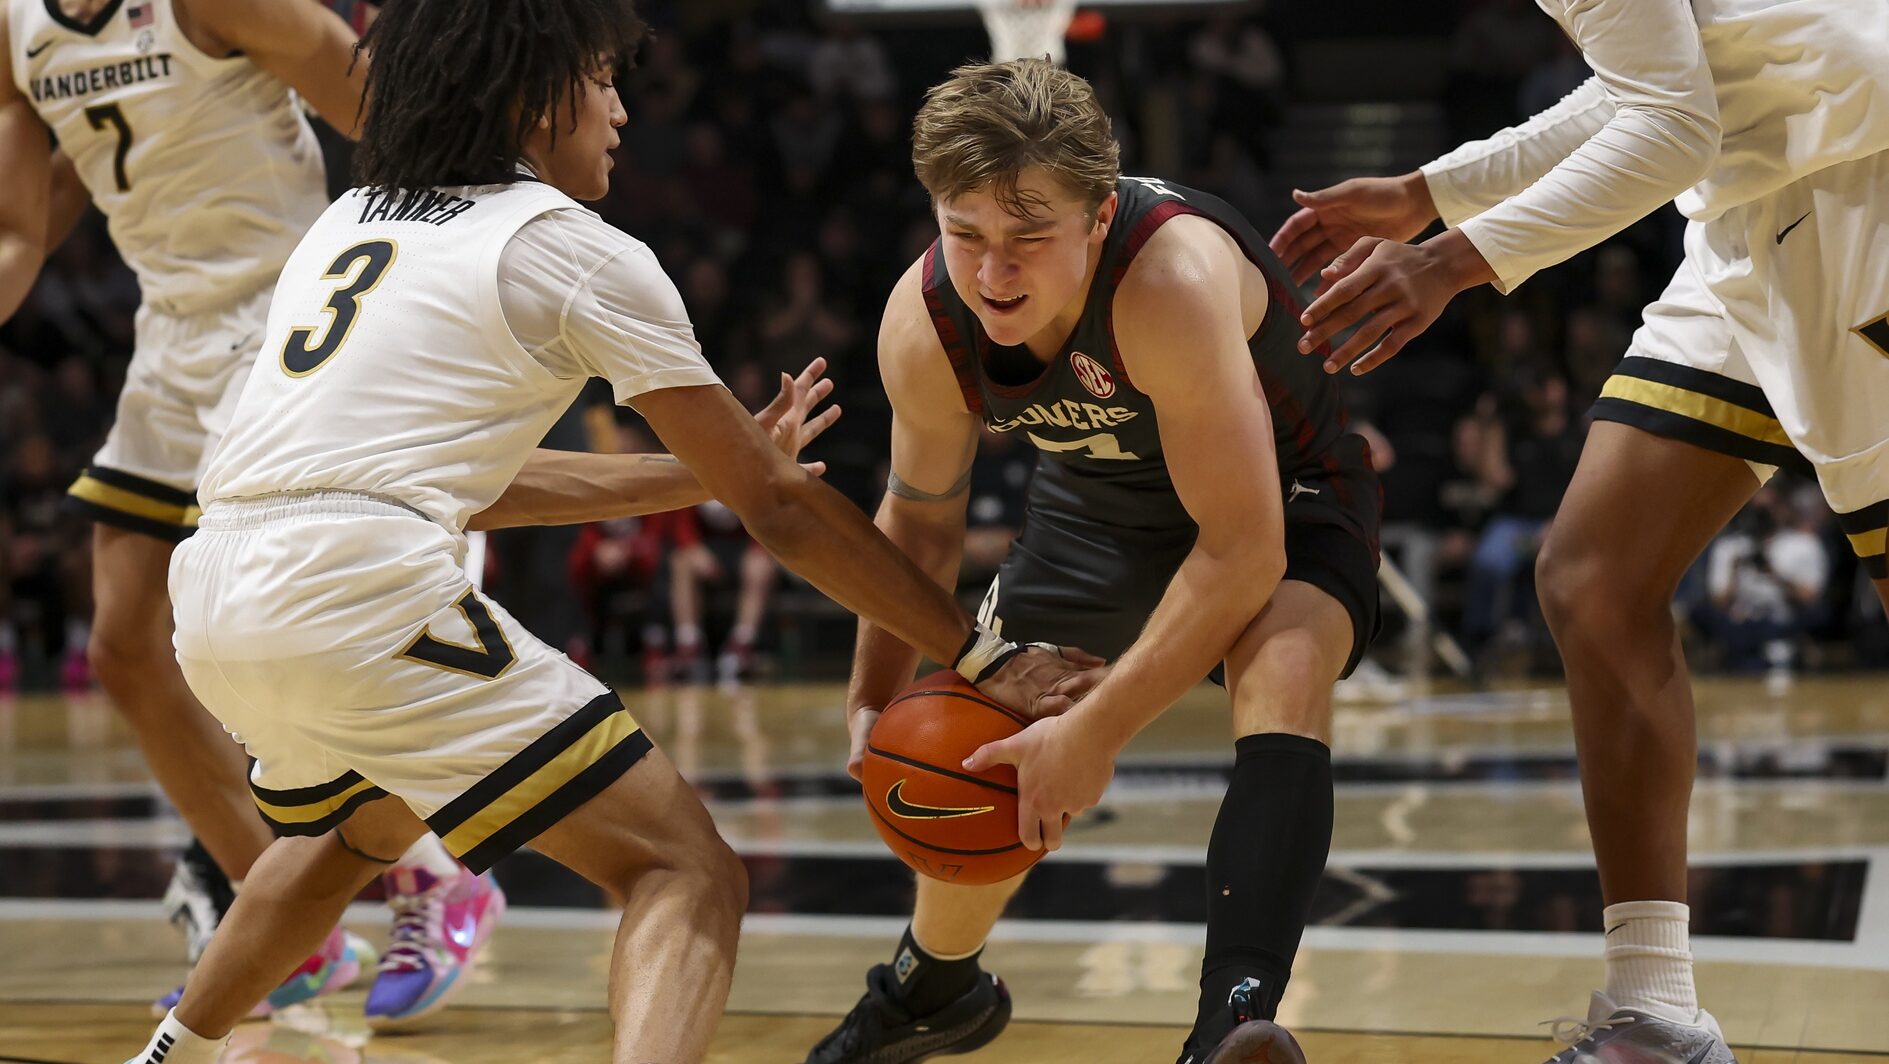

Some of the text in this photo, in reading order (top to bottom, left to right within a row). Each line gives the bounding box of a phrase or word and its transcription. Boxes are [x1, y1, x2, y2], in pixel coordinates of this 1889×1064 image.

[29, 54, 172, 101] VANDERBILT
[85, 103, 133, 193] 7
[358, 189, 476, 226] TANNER
[279, 238, 398, 378] 3
[1075, 354, 1112, 394] SEC
